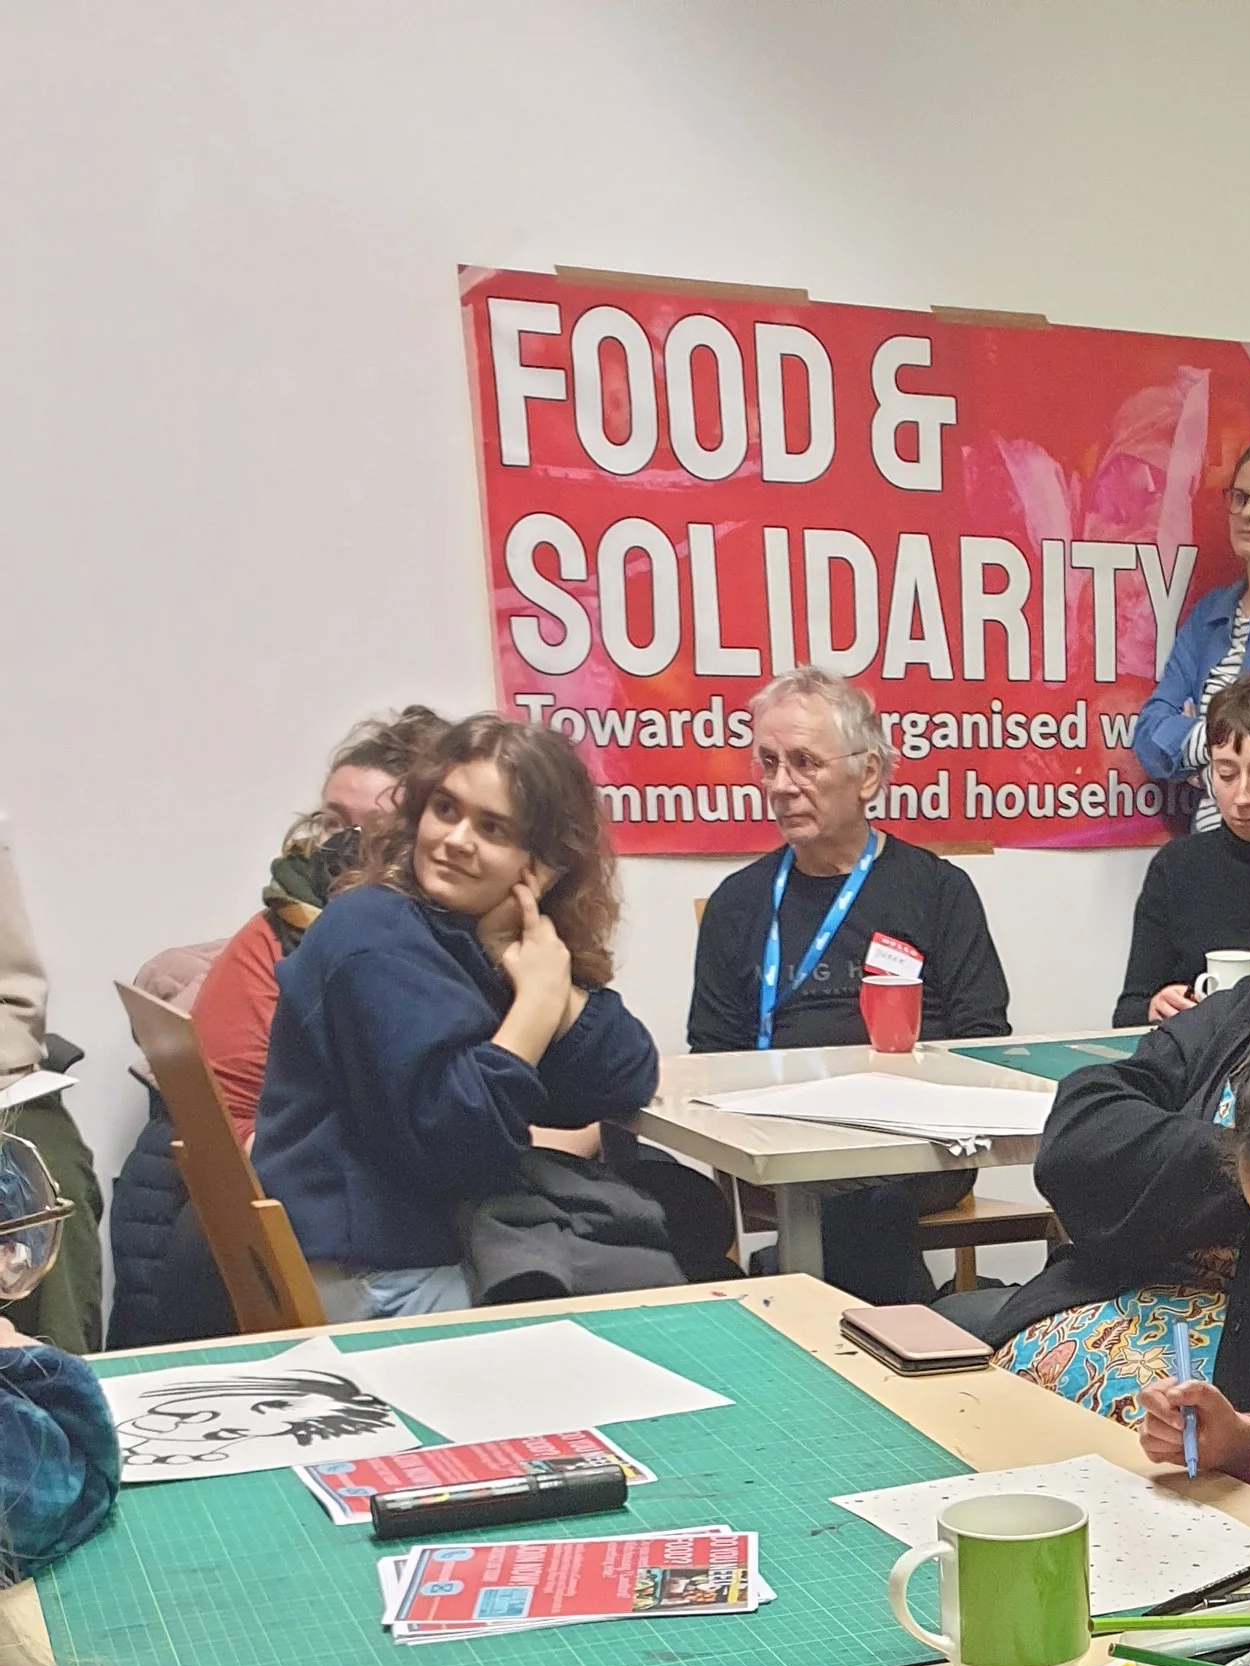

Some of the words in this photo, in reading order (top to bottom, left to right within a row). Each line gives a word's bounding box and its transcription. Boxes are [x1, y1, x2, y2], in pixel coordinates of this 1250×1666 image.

[487, 297, 836, 482] FOOD
[871, 335, 957, 492] &
[504, 511, 1198, 682] SOLIDARITY
[514, 692, 754, 748] Towards
[880, 698, 1087, 759] rganised
